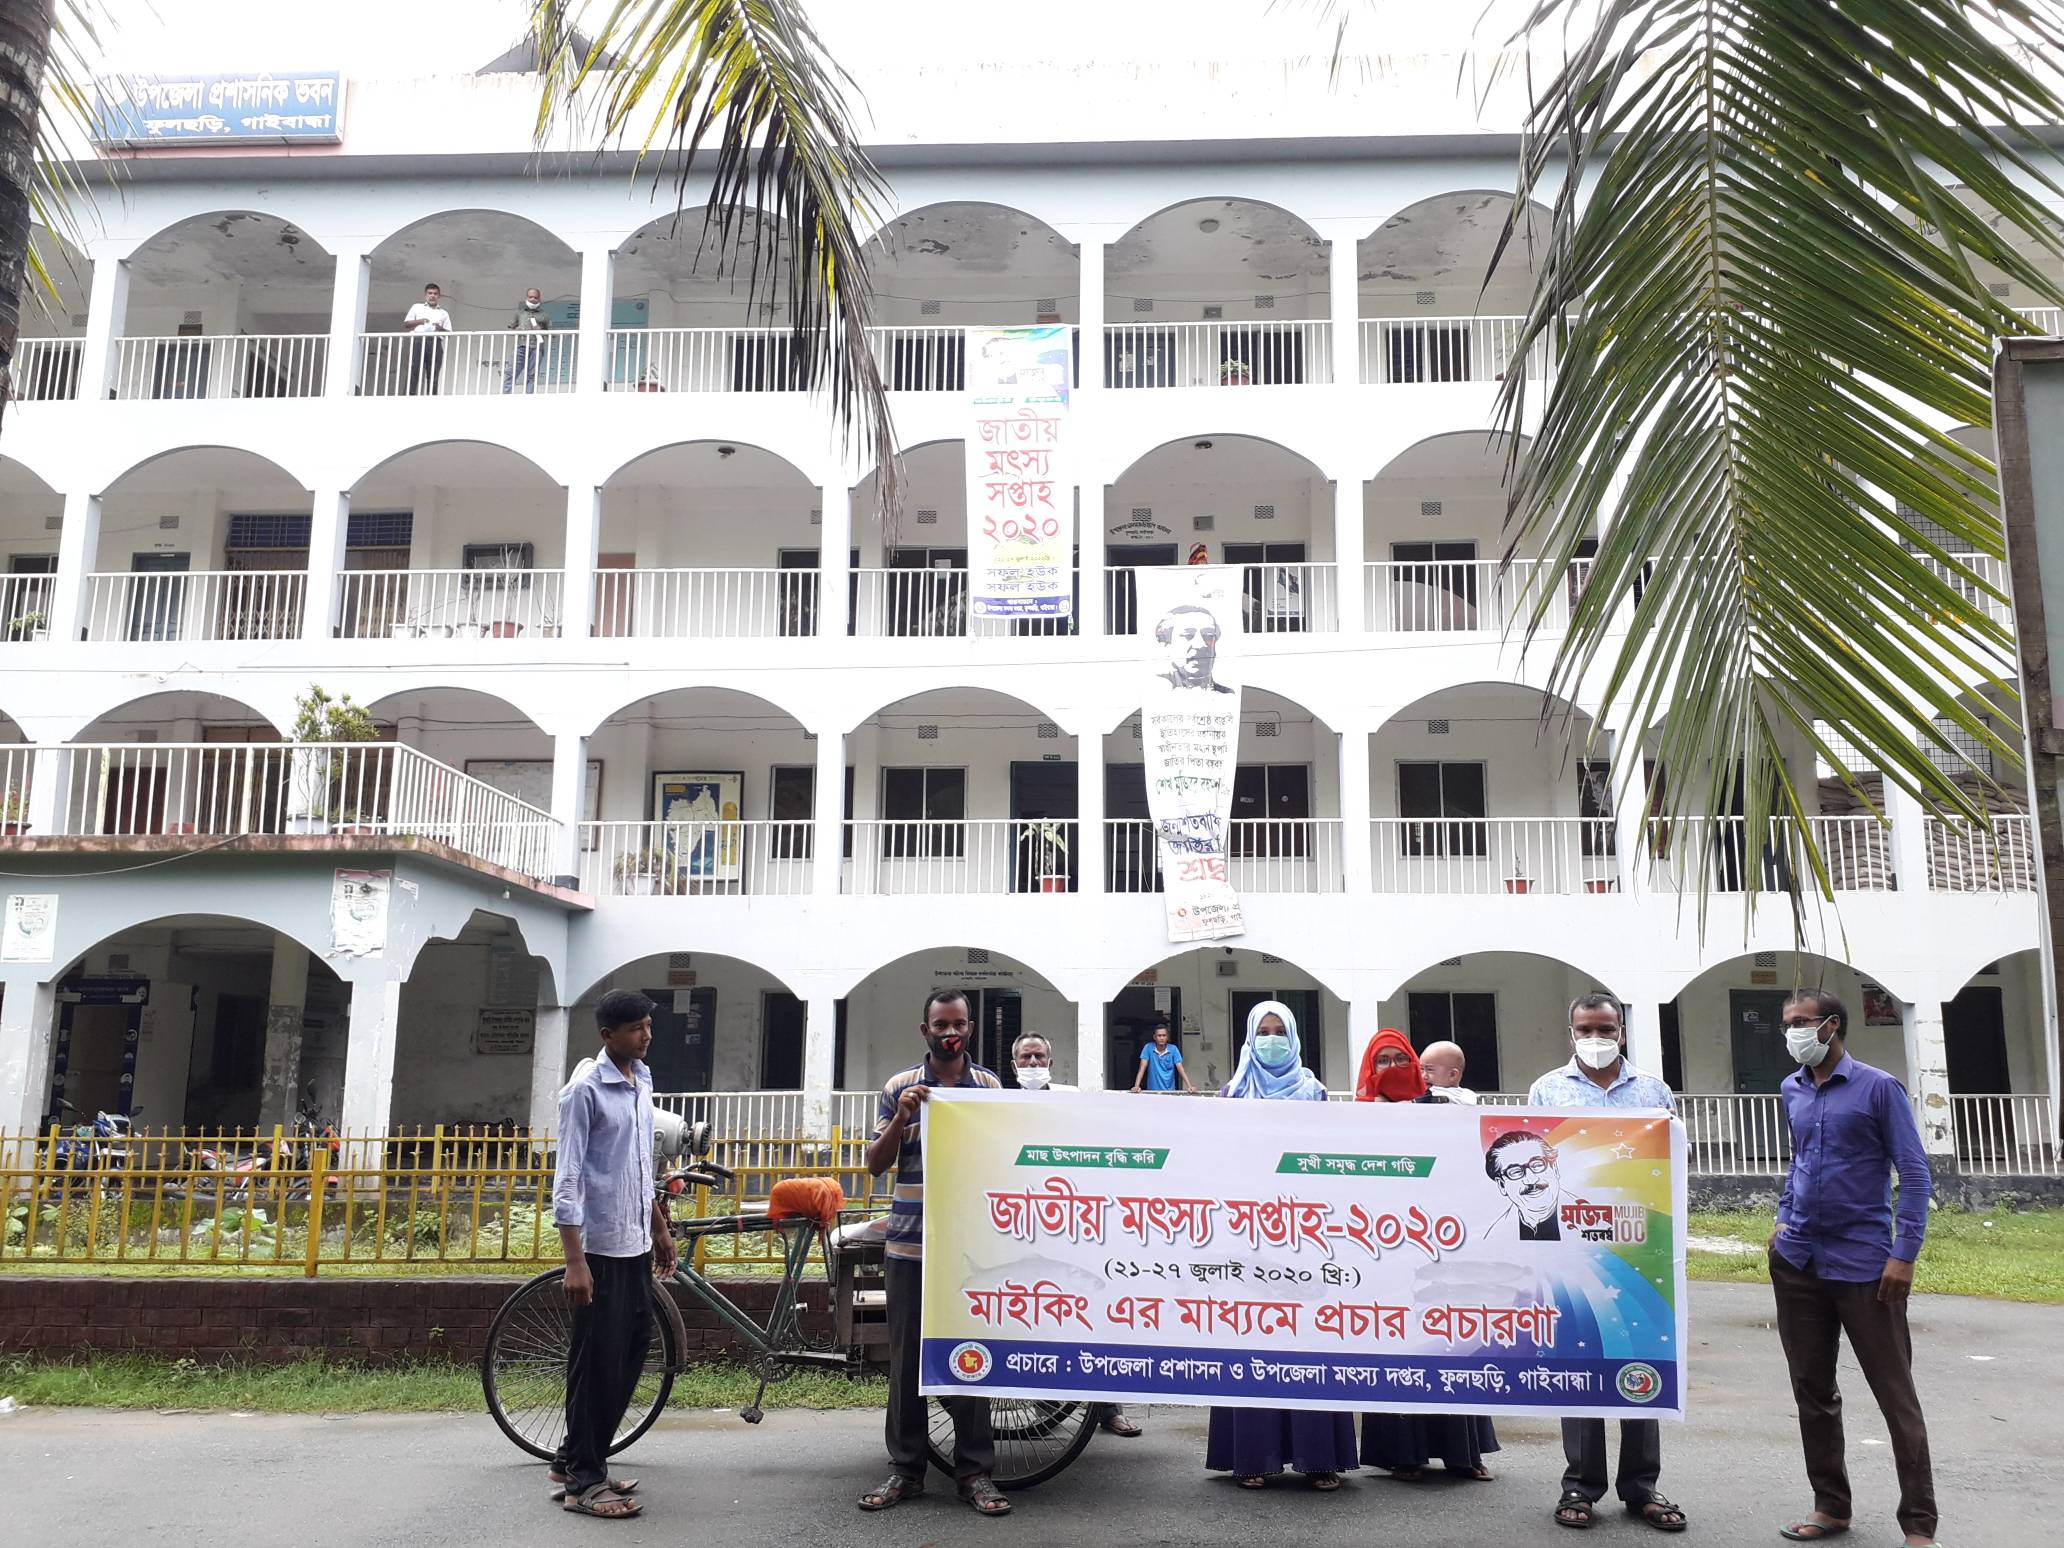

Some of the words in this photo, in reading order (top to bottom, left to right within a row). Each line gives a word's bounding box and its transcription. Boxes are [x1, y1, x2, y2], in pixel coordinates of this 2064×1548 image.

[132, 77, 205, 109] উপজেলা
[209, 73, 290, 109] প্রশাসনিক
[294, 78, 335, 106] ভবন
[976, 408, 1061, 445] জাতীয়
[985, 449, 1053, 476] মৎস্য
[985, 479, 1055, 510] সপ্তাহ
[983, 514, 1059, 543] ২০২০
[1026, 1149, 1049, 1162] মাছ
[1052, 1147, 1100, 1163] উৎপাদন
[1104, 1148, 1128, 1167] বৃদ্ধি
[1131, 1149, 1156, 1164] করি
[1296, 1155, 1321, 1172] সুখী
[1325, 1158, 1356, 1175] সমৃদ্ধ
[1361, 1159, 1387, 1172] দেশ
[1391, 1157, 1416, 1174] গড়ি
[985, 1176, 1111, 1243] জাতীয়
[1117, 1195, 1217, 1246] মৎস্য
[1225, 1191, 1465, 1261] সপ্তাহ-২০২০
[1561, 1199, 1613, 1229] মুজিব
[1614, 1205, 1645, 1219] MUJIB
[1581, 1229, 1613, 1242] শতবর্ষ
[1614, 1220, 1646, 1242] 100
[1104, 1257, 1180, 1280] (২১-২৭
[1189, 1259, 1245, 1284] জুলাই
[1254, 1263, 1312, 1285] ২০২০
[964, 1280, 1093, 1331] মাইকিং
[1106, 1296, 1165, 1329] এর
[1174, 1295, 1303, 1337] মাধ্যমে
[1314, 1301, 1411, 1341] প্রচার
[1422, 1302, 1559, 1348] প্রচারণা
[1006, 1351, 1059, 1374] প্রচারে
[1079, 1350, 1152, 1378] উপজেলা
[1159, 1356, 1222, 1381] প্রশাসন
[1230, 1362, 1243, 1380] ও
[1250, 1355, 1328, 1385] উপজেলা
[1333, 1366, 1377, 1387] মৎস্য
[1384, 1366, 1431, 1392] দপ্তর,
[1438, 1364, 1510, 1393] ফুলছড়ি,
[1518, 1366, 1591, 1392] গাইবান্ধা
